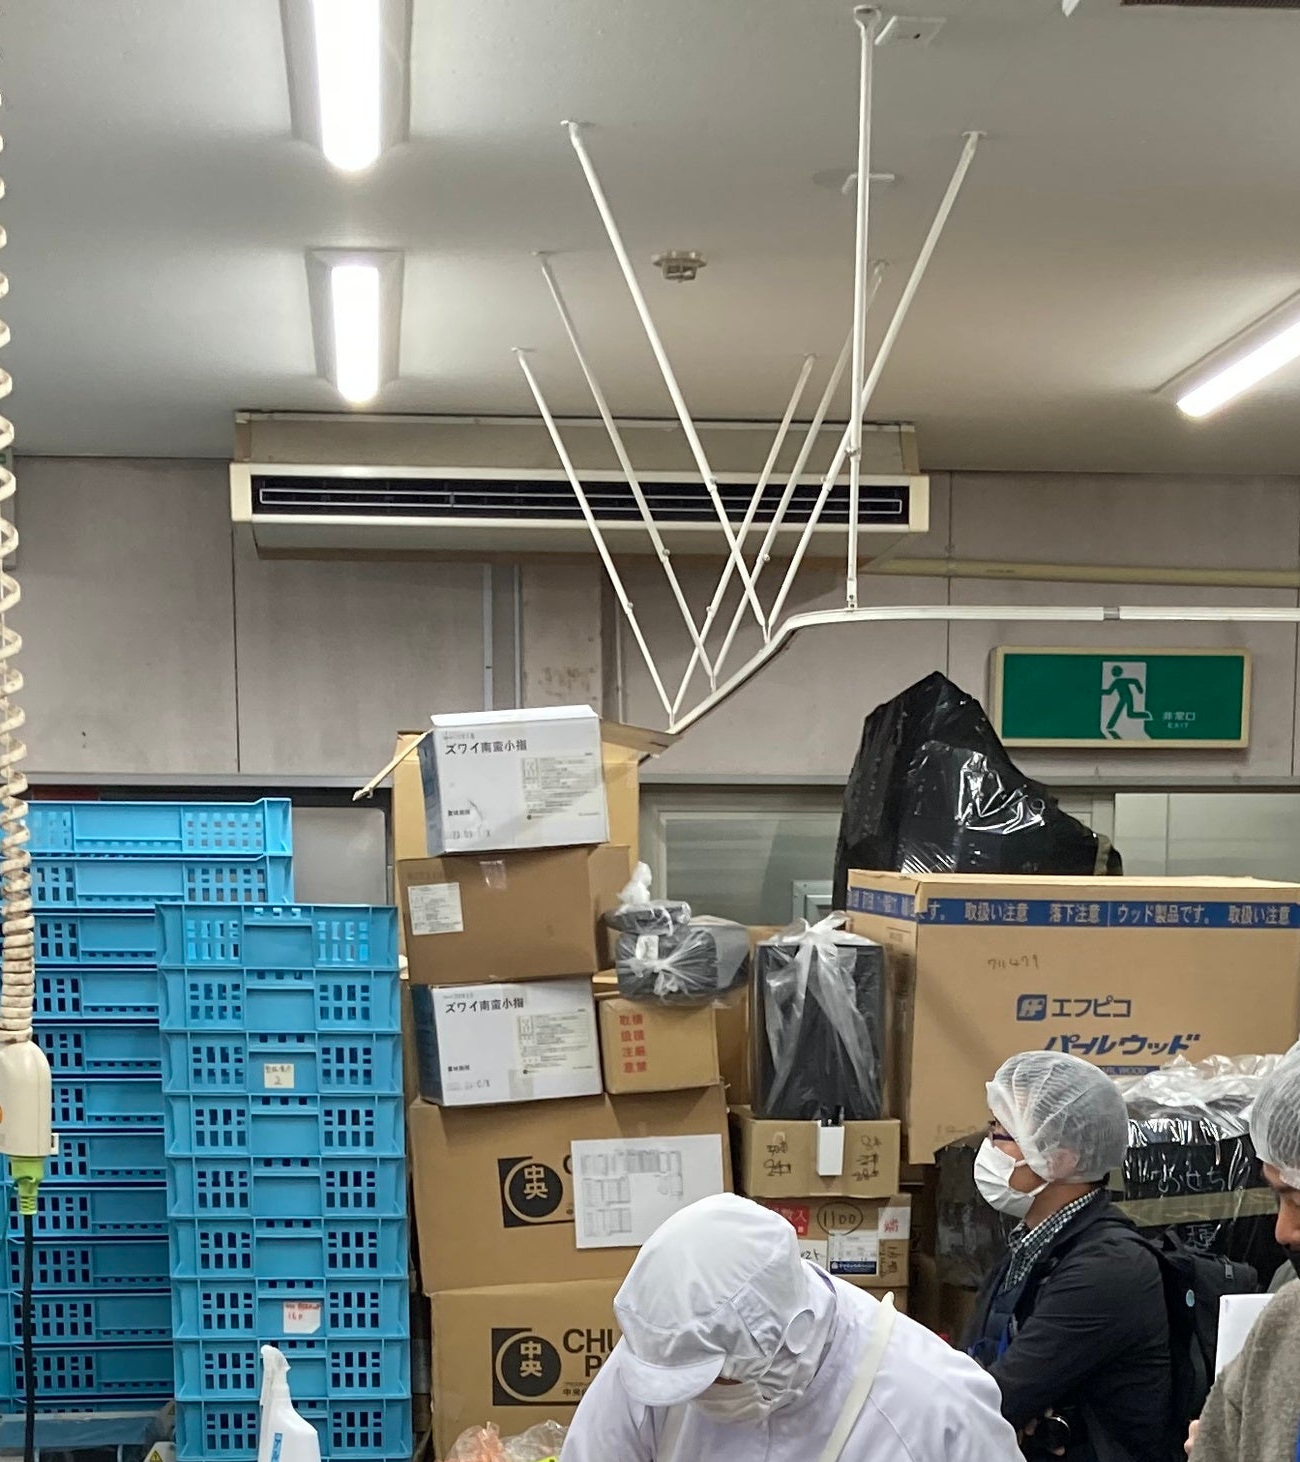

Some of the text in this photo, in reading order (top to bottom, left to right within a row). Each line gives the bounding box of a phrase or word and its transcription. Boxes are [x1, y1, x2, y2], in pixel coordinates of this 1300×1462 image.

[1163, 711, 1196, 721] 非常口
[964, 902, 1029, 923] 取扱い注意
[1049, 903, 1101, 923] 落下注意
[1117, 904, 1210, 925] ウッド製品です。
[1228, 905, 1290, 926] 取扱い注意
[1052, 995, 1132, 1018] エフピコ
[1043, 1034, 1200, 1056] パールウッド
[523, 1165, 549, 1200] 中央
[520, 1341, 543, 1377] 中央
